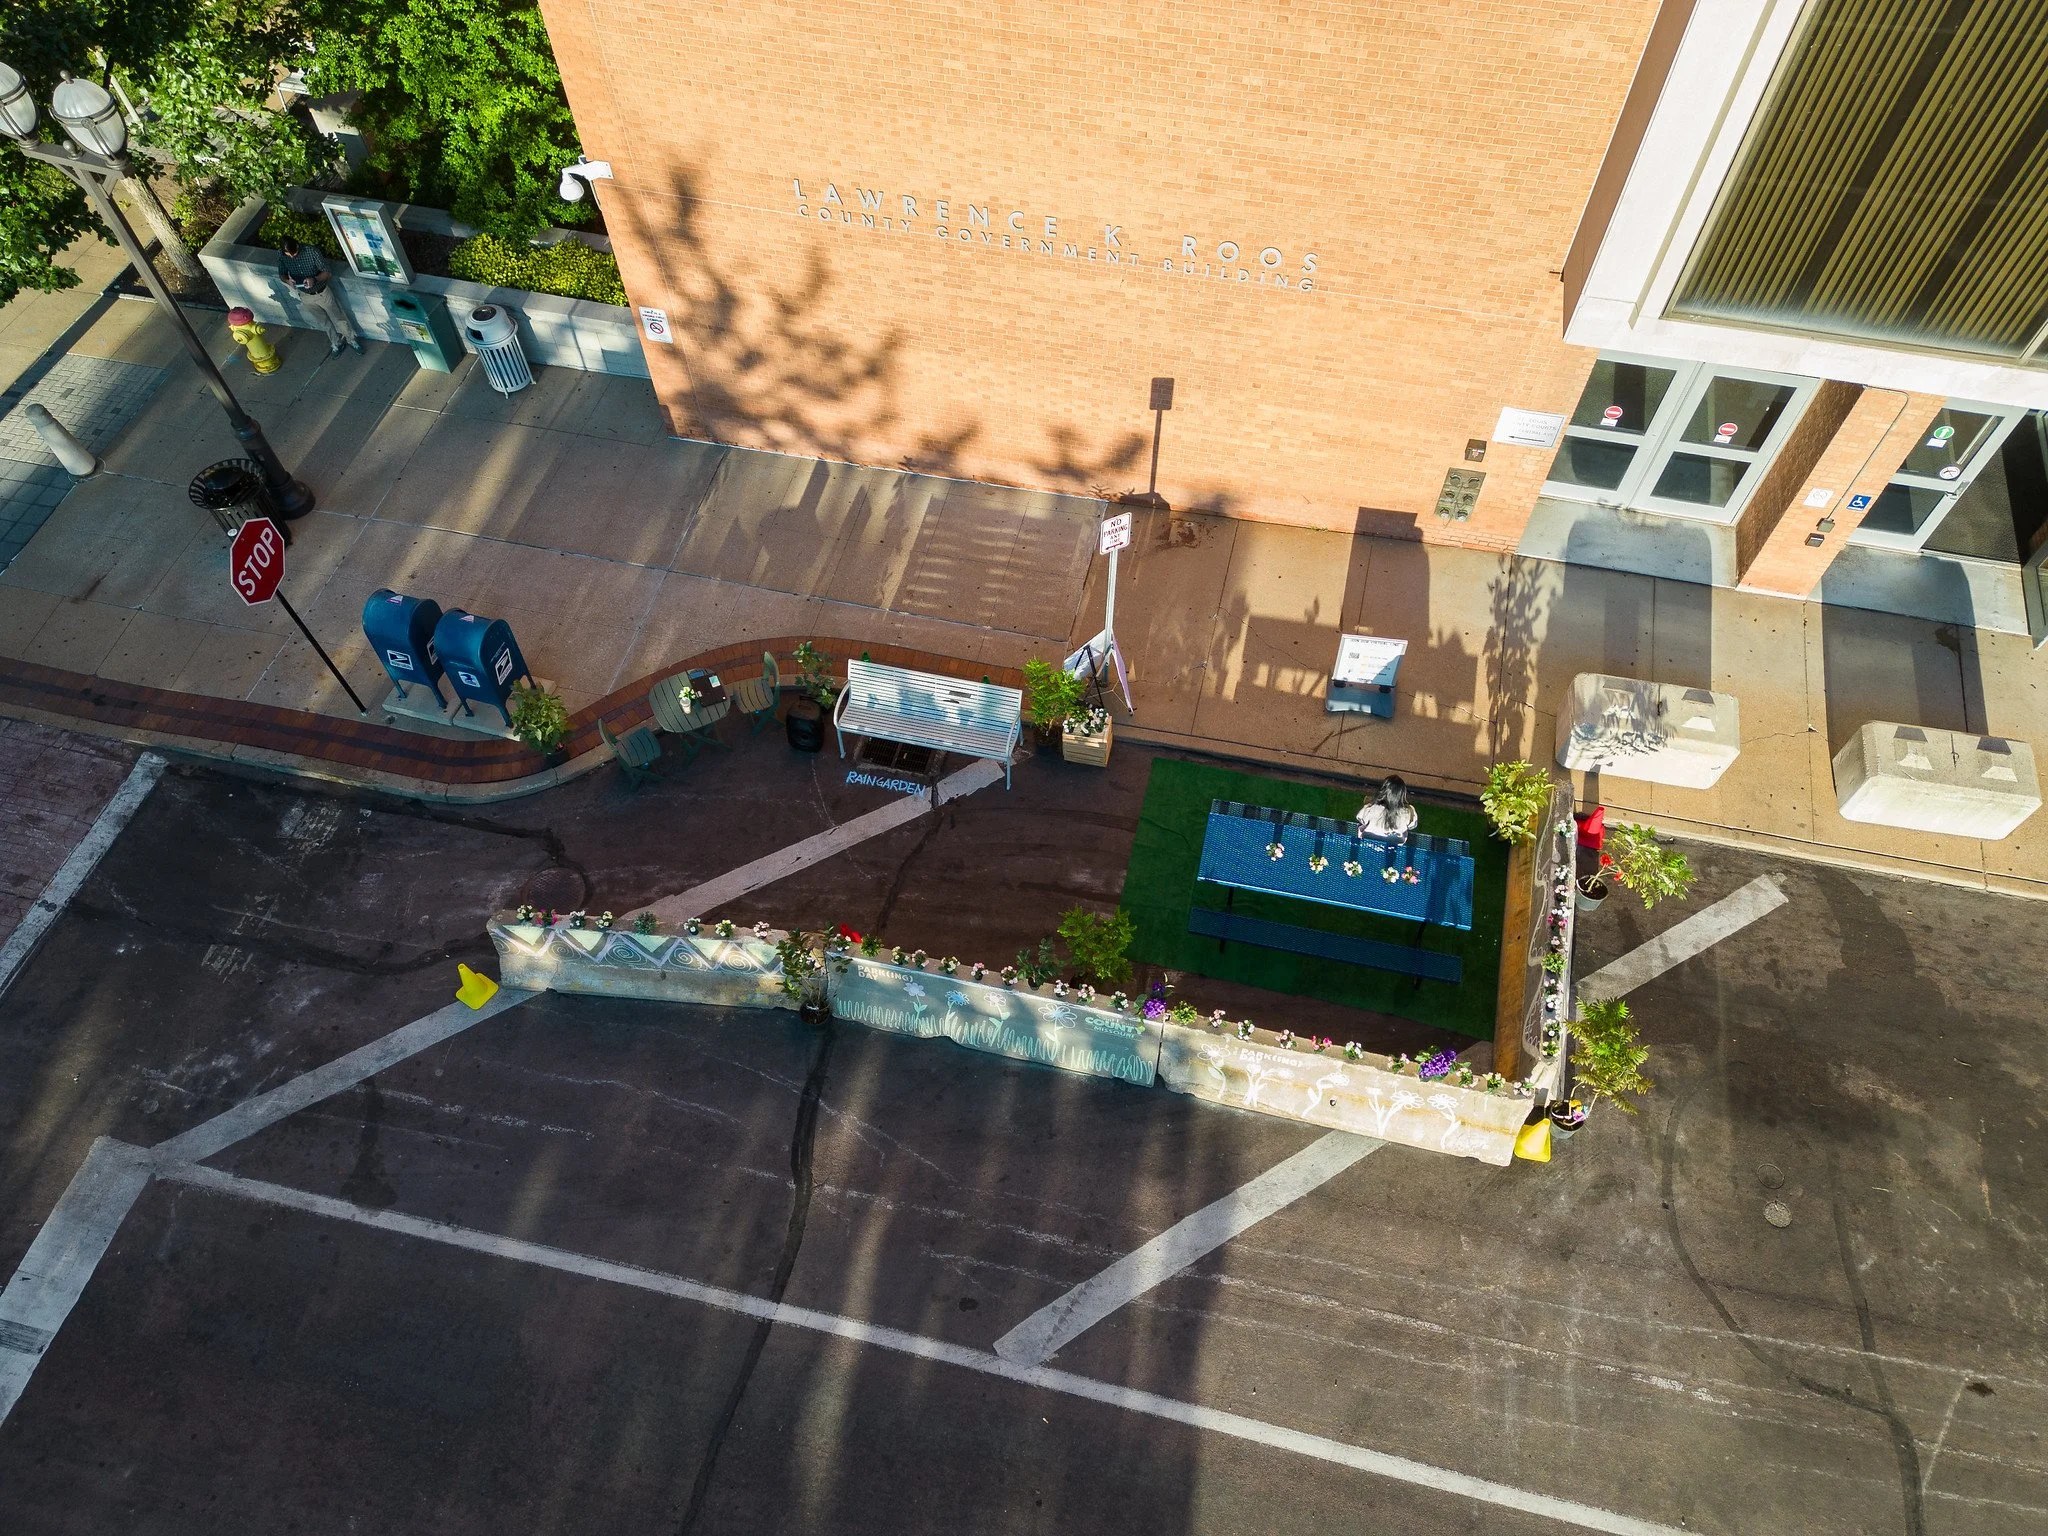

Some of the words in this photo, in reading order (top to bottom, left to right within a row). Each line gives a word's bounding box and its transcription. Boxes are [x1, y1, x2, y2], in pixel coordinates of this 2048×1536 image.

[793, 178, 1057, 237] LAWRENCE
[1181, 234, 1319, 275] ROOS
[797, 204, 912, 233] COUNTY
[936, 225, 1139, 267] GOVERNMENT
[1163, 258, 1314, 292] BUILDING
[1104, 523, 1128, 537] PARKING
[1111, 518, 1122, 528] NO
[238, 527, 275, 596] STOP
[857, 964, 914, 983] PARK(ING)
[858, 970, 879, 981] DAY
[1085, 1016, 1144, 1035] COUNTY
[1093, 1025, 1135, 1038] MISSOURI
